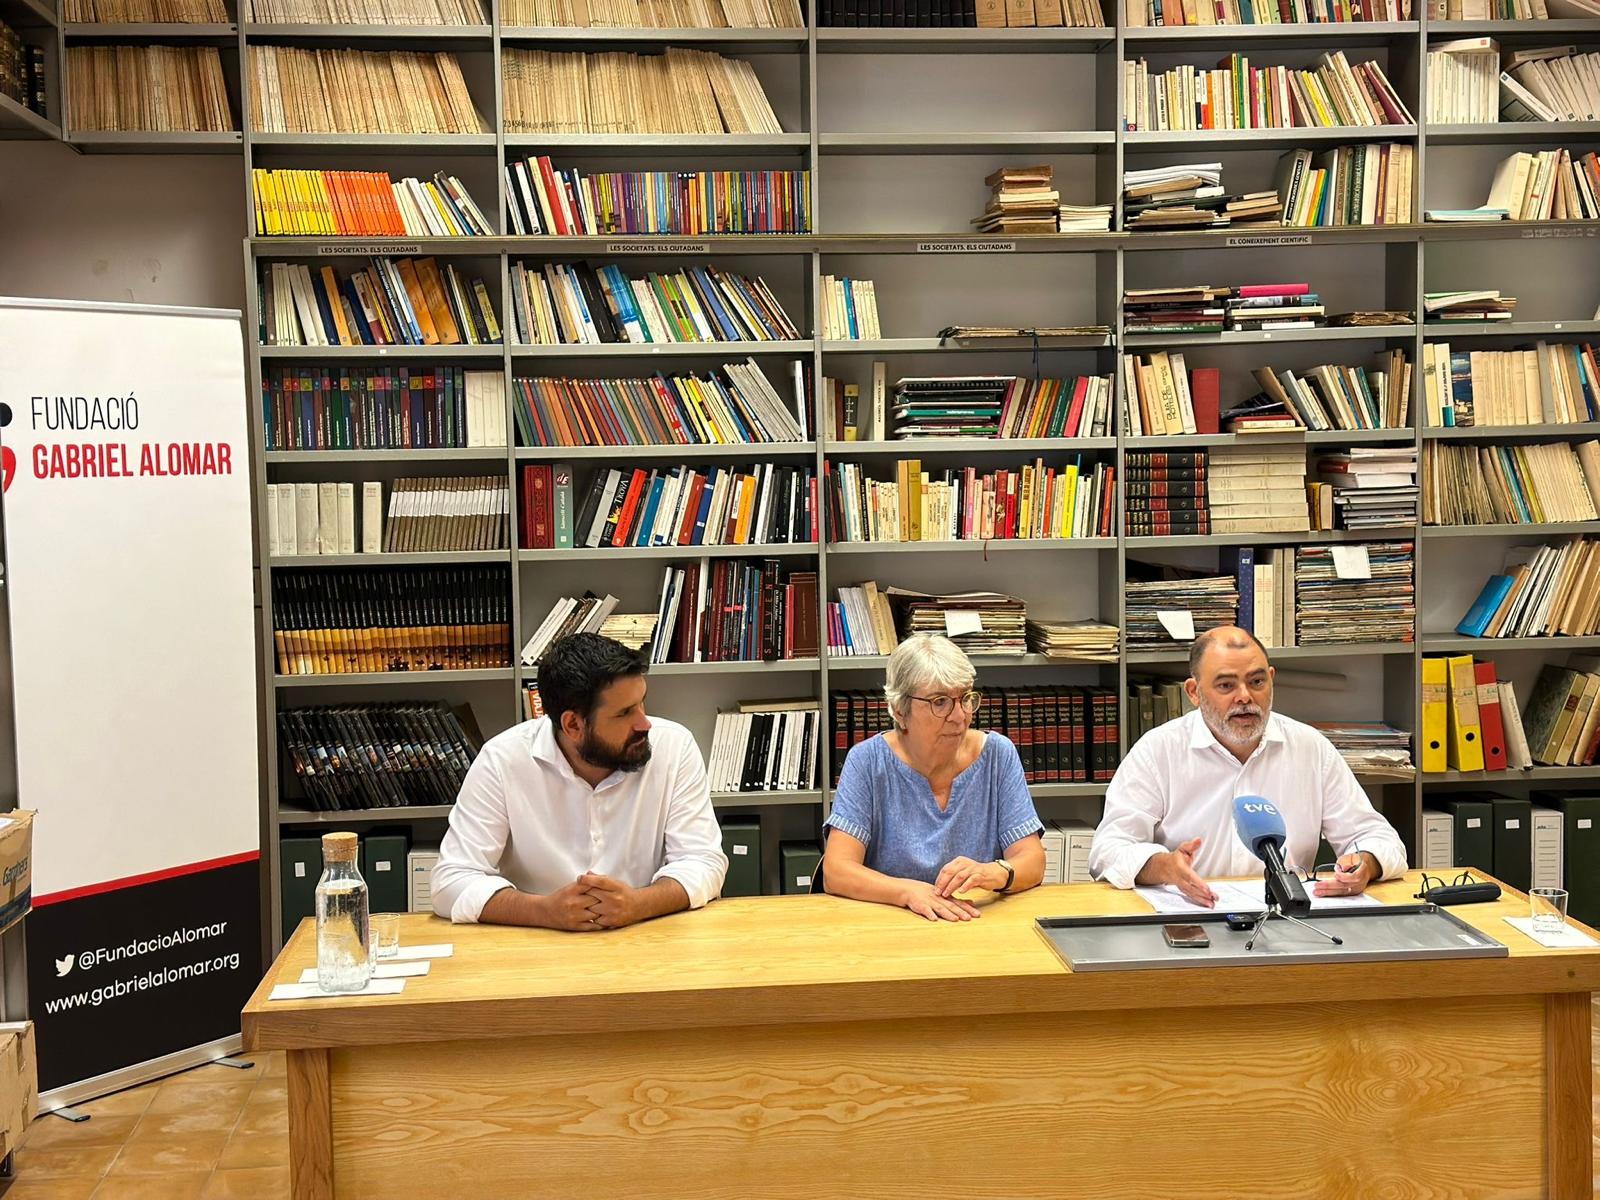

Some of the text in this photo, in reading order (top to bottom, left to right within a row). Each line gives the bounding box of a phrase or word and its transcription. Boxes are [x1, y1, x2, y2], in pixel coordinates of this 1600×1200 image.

[382, 246, 418, 254] CIUTADANS
[977, 243, 1012, 251] CIUTADANS
[1237, 237, 1280, 245] CONEIXEMENT
[31, 391, 139, 430] FUNDACIÓ
[32, 442, 232, 479] GABRIEL ALOMAR
[1243, 803, 1277, 815] tve
[78, 920, 227, 970] @FundacioAlomar
[45, 953, 240, 1014] www.gabrielalomar.org
